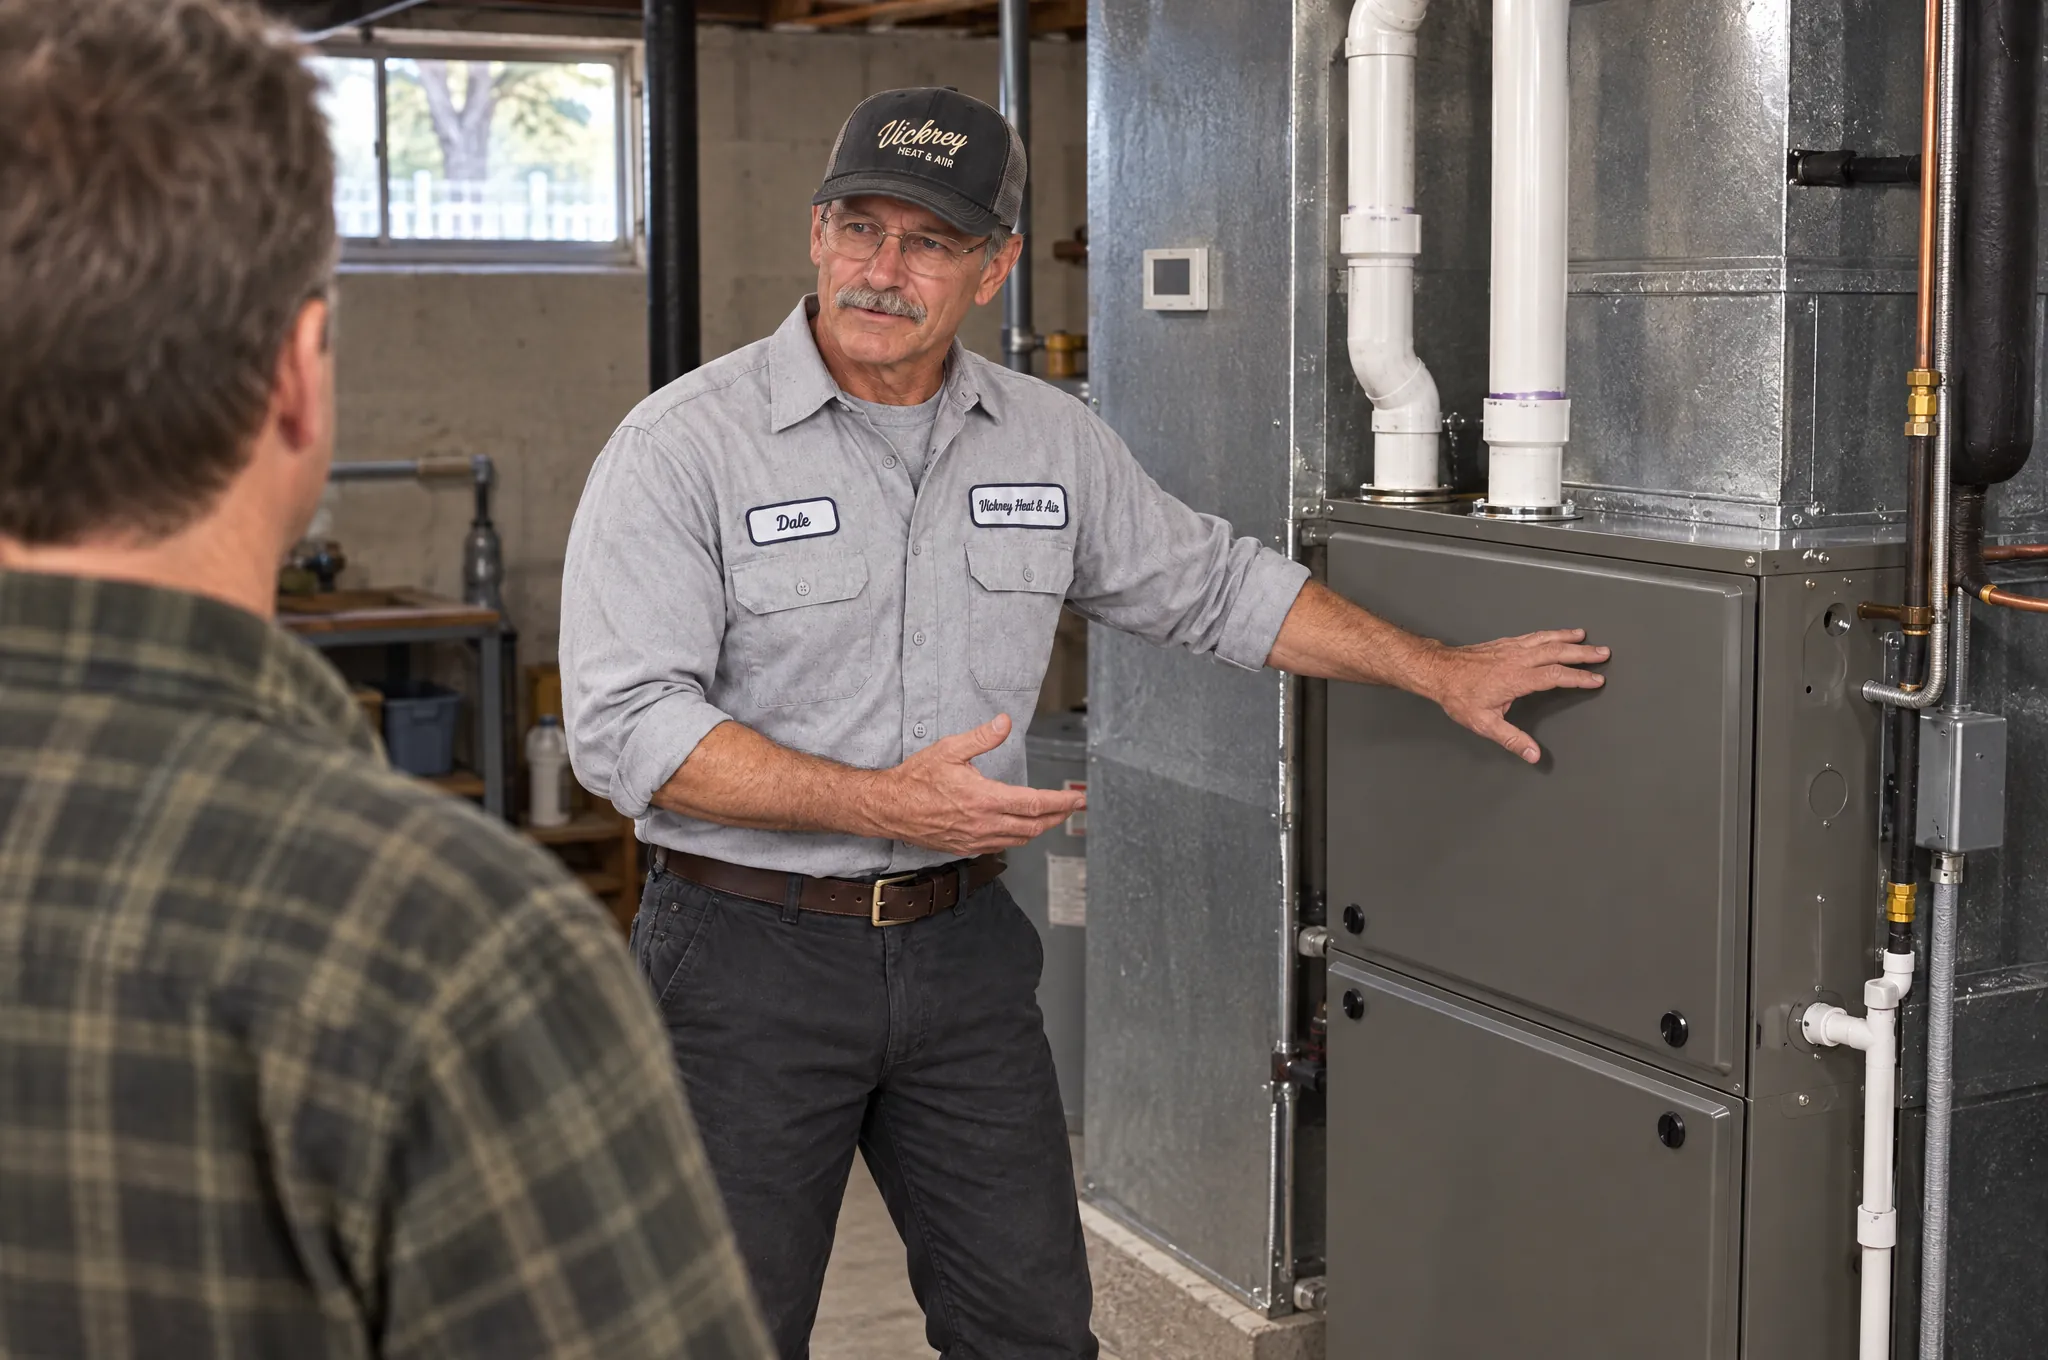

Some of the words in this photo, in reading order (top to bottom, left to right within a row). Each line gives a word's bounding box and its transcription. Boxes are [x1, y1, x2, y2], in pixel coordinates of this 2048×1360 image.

[877, 119, 968, 156] Vickrey
[897, 146, 925, 159] HEAT
[925, 152, 932, 162] &
[1014, 498, 1035, 512] Heat
[1035, 499, 1043, 512] &
[1044, 499, 1060, 513] Air
[776, 511, 811, 532] Dale
